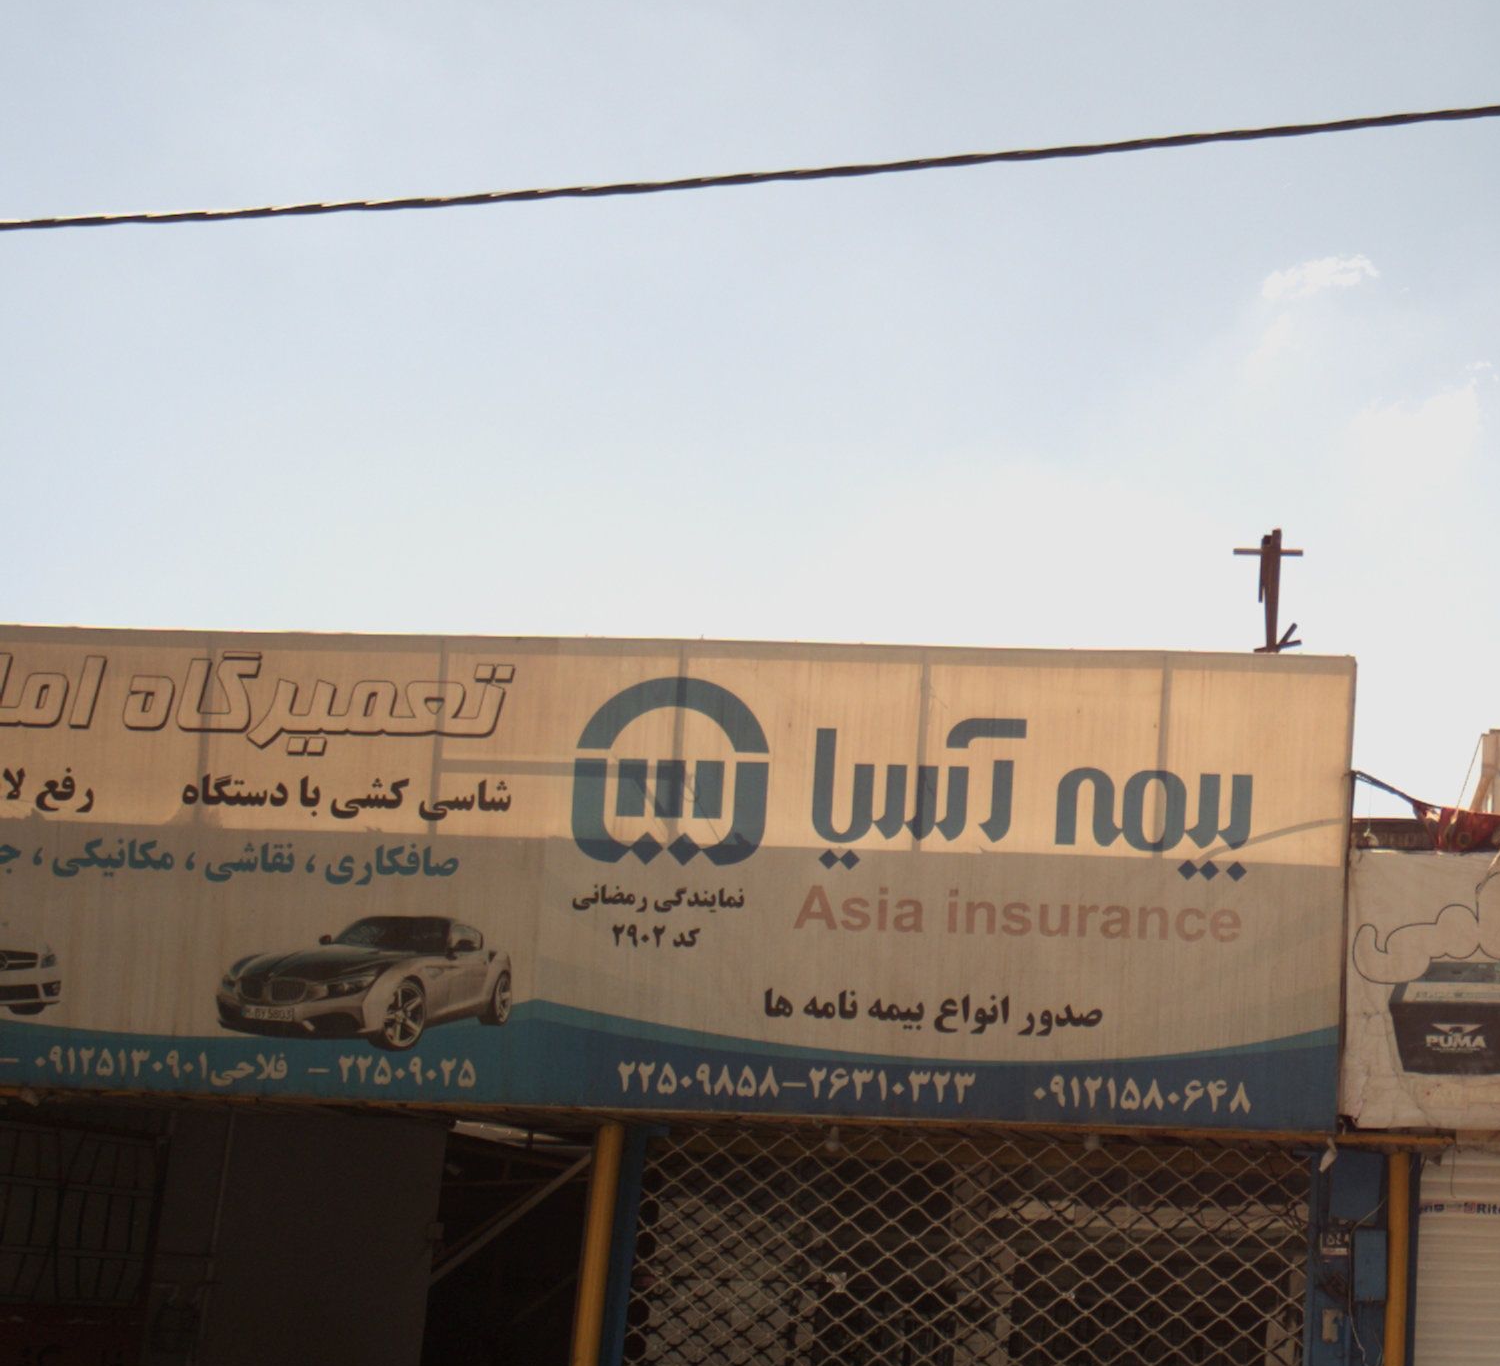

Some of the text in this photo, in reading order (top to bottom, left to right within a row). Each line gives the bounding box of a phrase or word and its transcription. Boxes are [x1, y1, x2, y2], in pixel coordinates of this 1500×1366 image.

[124, 651, 515, 755] تعمیرگاه
[35, 767, 95, 813] رفع
[181, 772, 289, 808] دستگاه
[299, 775, 321, 816] با
[330, 777, 410, 818] کشی
[418, 778, 512, 820] شاسی
[811, 718, 1253, 881] بیمه آسیا
[52, 838, 174, 877] مکانیکی
[204, 843, 295, 882] نقاشی
[324, 845, 459, 885] صافکاری
[572, 884, 745, 913] نمایندگی رمضانی
[794, 884, 1243, 943] Asia insurance
[612, 923, 701, 948] کد ۲۹۰۲
[763, 987, 1104, 1036] صدور انواع بیمه نامه ها
[1424, 1034, 1487, 1048] PUMA
[338, 1055, 477, 1089] ۲۲۵۰۹۰۲۵
[1032, 1073, 1252, 1115] ۰۹۱۲۱۵۸۰۶۴۸
